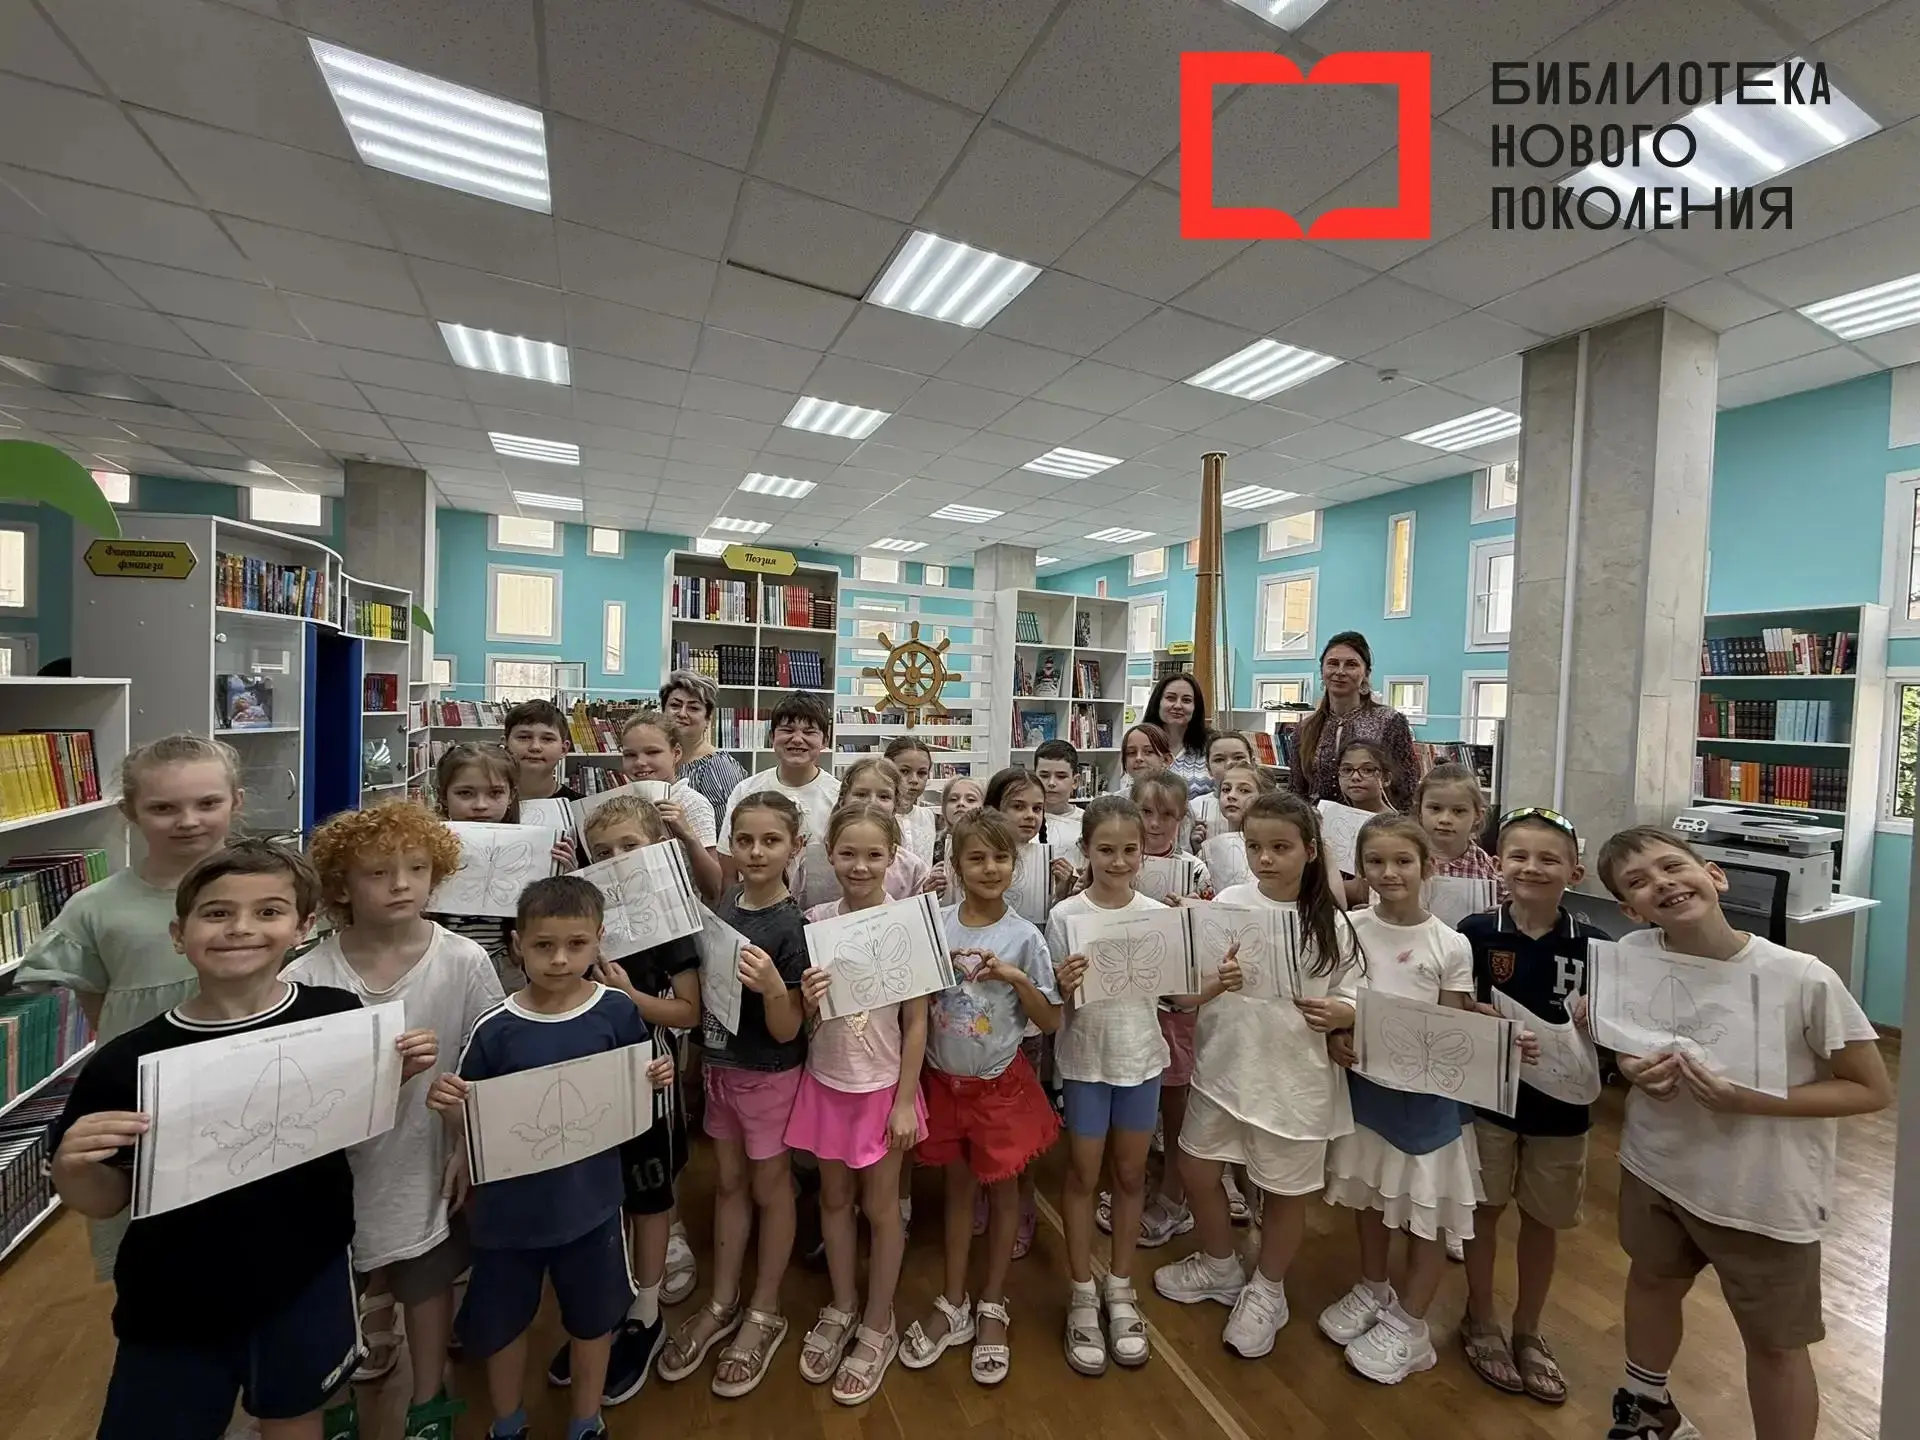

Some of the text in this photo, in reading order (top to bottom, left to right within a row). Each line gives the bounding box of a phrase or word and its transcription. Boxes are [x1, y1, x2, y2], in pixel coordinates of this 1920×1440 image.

[745, 553, 777, 566] Поэзия
[1553, 955, 1584, 995] H
[631, 1157, 665, 1192] 10
